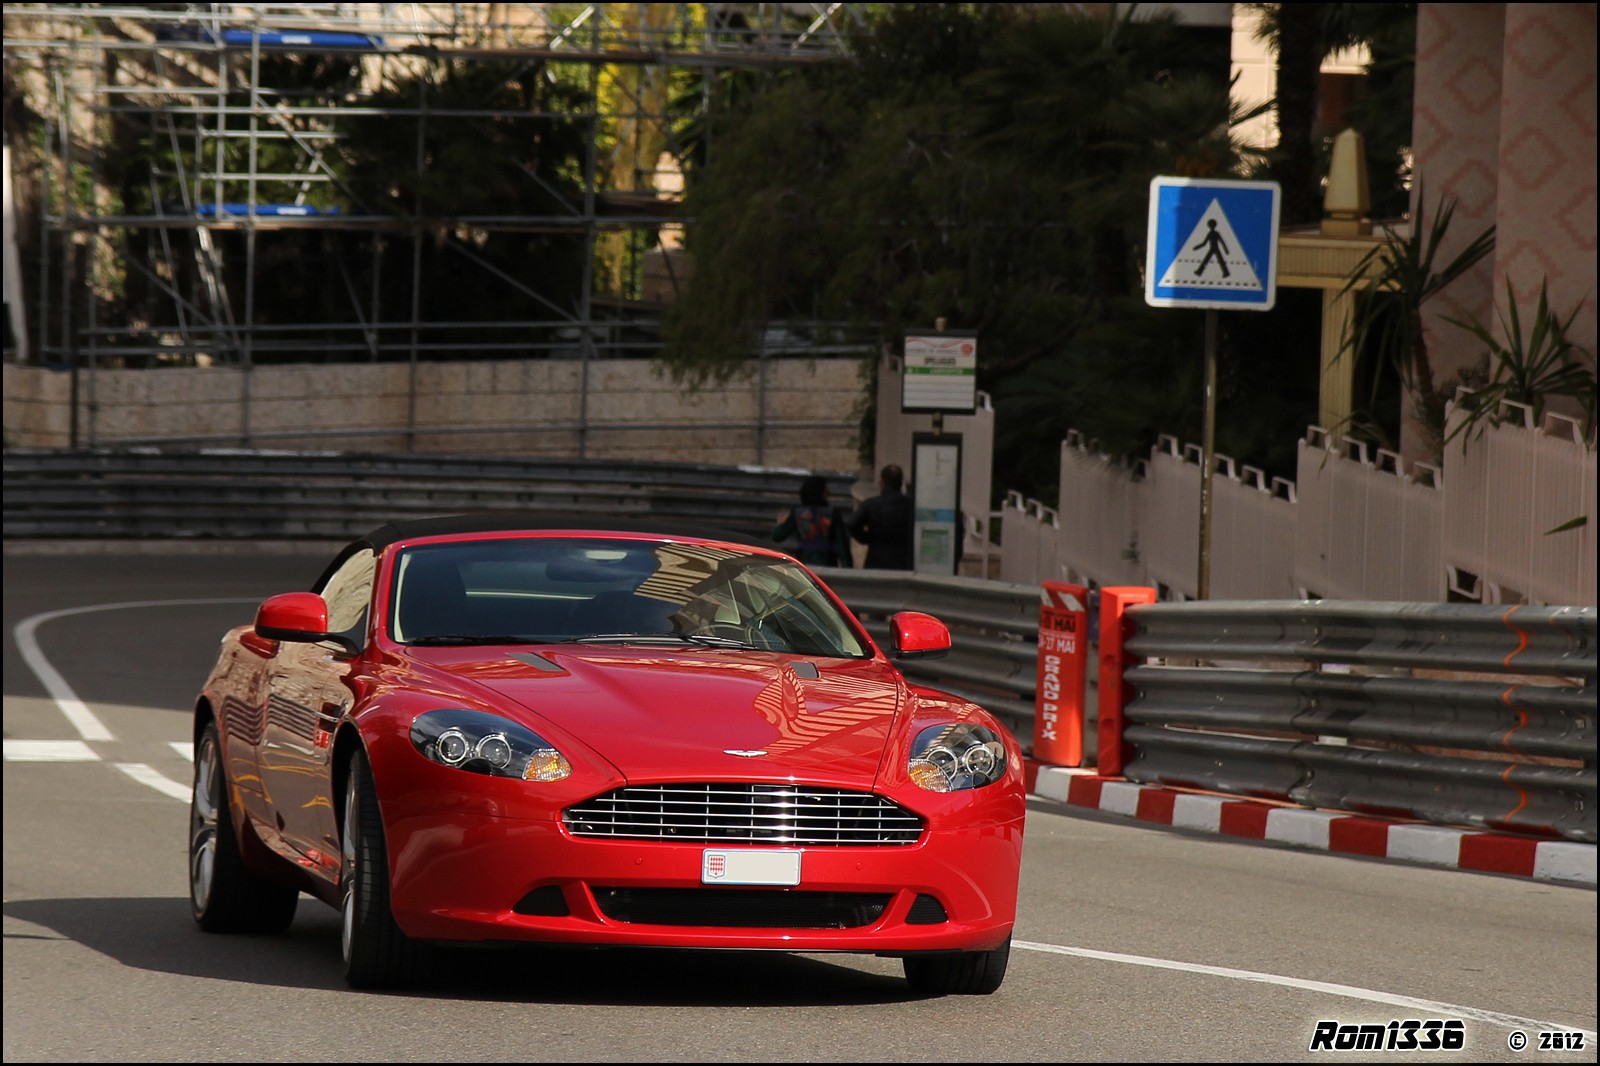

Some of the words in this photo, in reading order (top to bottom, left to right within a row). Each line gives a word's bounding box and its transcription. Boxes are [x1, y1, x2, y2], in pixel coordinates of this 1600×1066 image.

[1054, 617, 1075, 633] MAI
[1056, 638, 1075, 654] MAI
[1043, 655, 1061, 700] GRAND
[1041, 702, 1058, 741] PRIX
